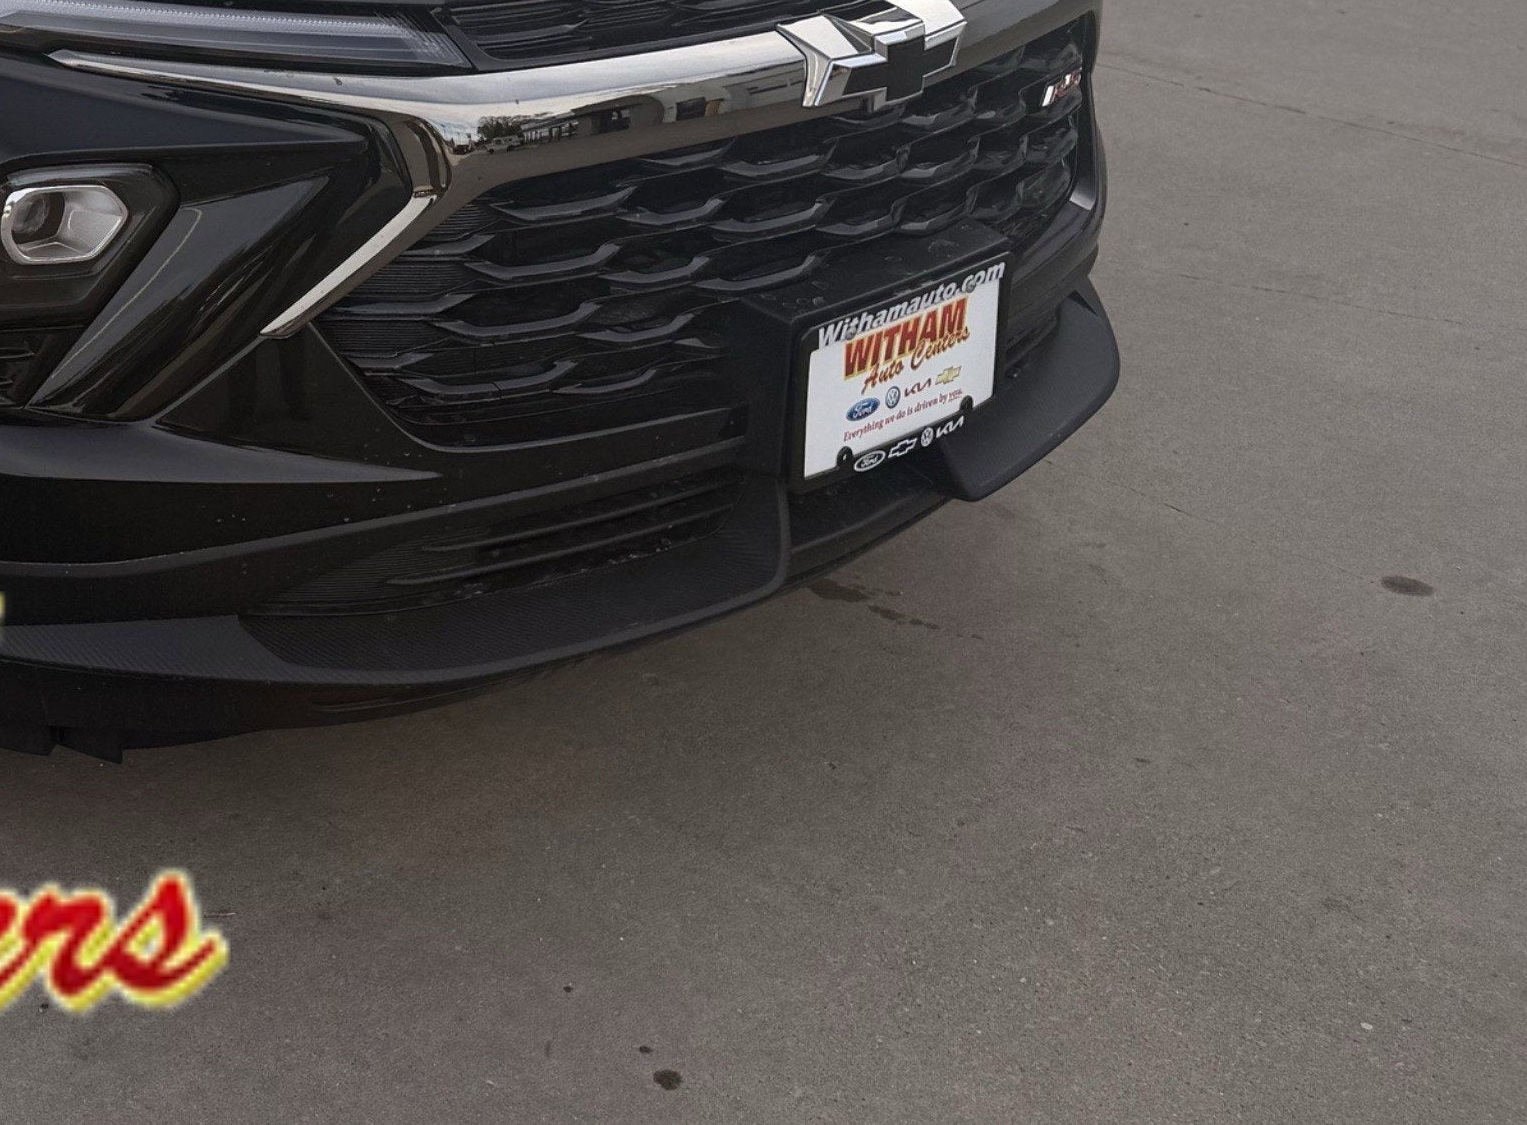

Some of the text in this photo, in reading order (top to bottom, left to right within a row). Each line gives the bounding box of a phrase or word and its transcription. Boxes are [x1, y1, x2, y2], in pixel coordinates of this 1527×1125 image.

[843, 297, 969, 379] WITHAM
[860, 326, 970, 395] Auto Centers
[843, 420, 884, 442] Everything
[884, 415, 895, 426] we
[896, 410, 906, 420] do
[907, 406, 913, 416] is
[914, 398, 938, 413] driven
[939, 393, 948, 405] by
